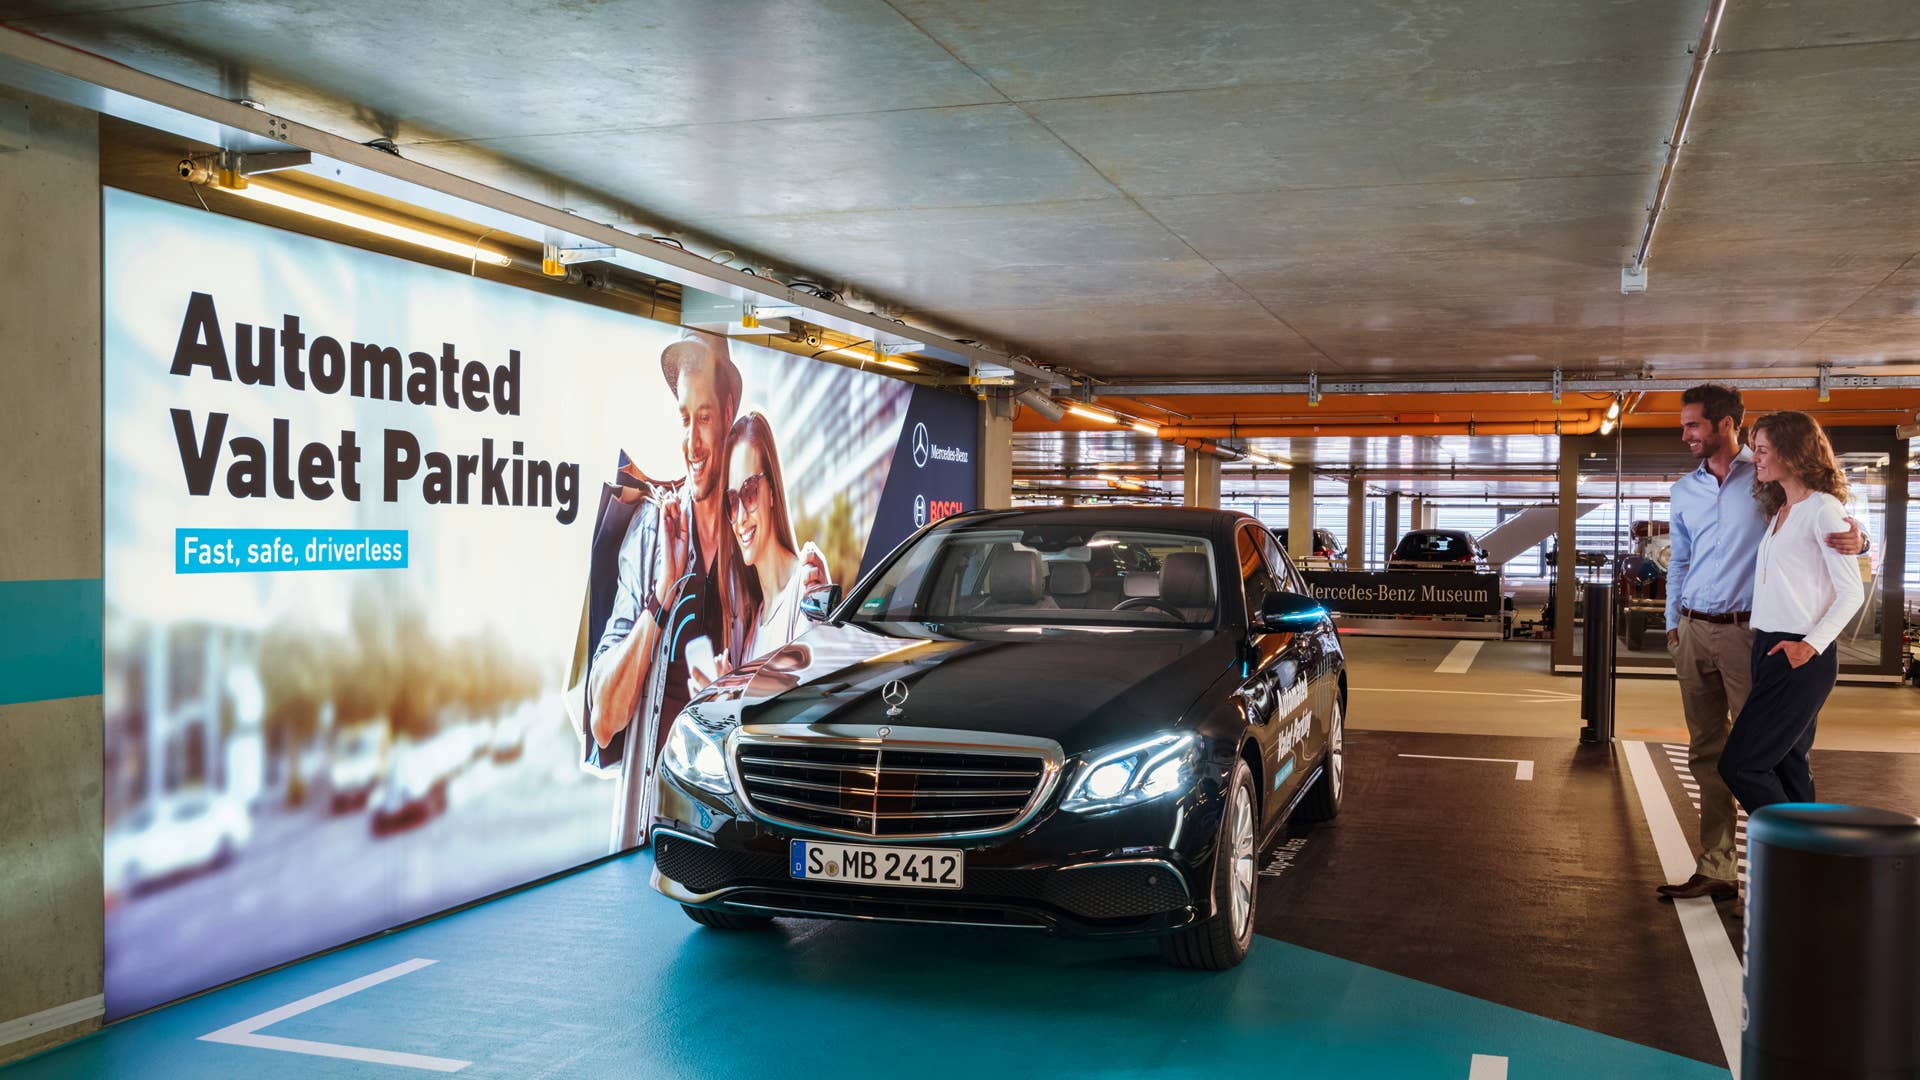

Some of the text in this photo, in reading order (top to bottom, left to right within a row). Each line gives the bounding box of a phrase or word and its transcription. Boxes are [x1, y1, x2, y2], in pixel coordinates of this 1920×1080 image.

[169, 291, 521, 416] Automated
[169, 408, 580, 525] Valet Parking
[930, 443, 968, 463] Mercedes-Benz
[929, 500, 963, 522] BOSCH
[184, 536, 402, 568] Fast, safe, driverless
[1421, 584, 1488, 602] Museum
[796, 847, 957, 884] D S MB 2412
